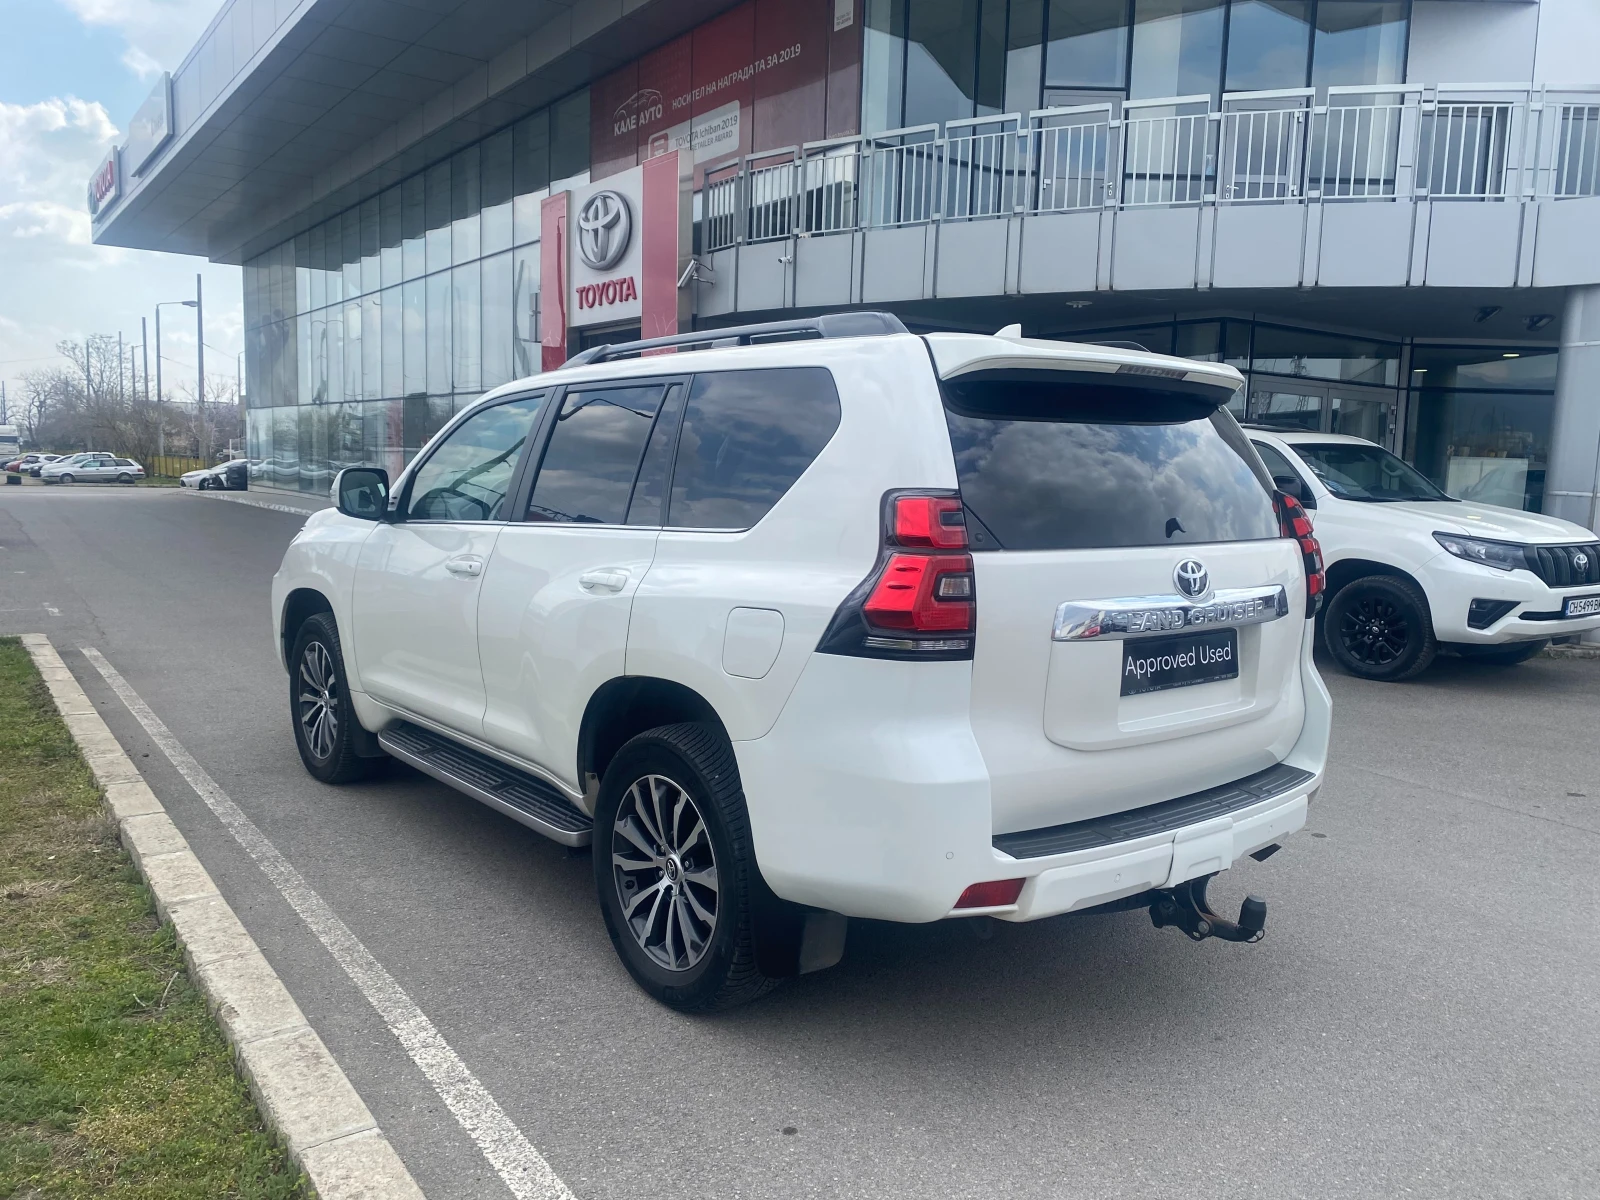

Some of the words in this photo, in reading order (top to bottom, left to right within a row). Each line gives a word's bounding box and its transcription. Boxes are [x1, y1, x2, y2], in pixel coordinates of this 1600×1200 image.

[705, 81, 718, 96] НА
[766, 53, 778, 69] ЗА
[779, 43, 801, 63] 2019
[638, 103, 663, 127] АУТО
[699, 123, 721, 139] Ichiban
[721, 114, 738, 130] 2019
[575, 276, 638, 310] TOYOTA
[1126, 610, 1185, 633] LAND
[1191, 600, 1265, 626] CRUISER
[1125, 646, 1196, 680] Approved
[1199, 641, 1232, 665] Used
